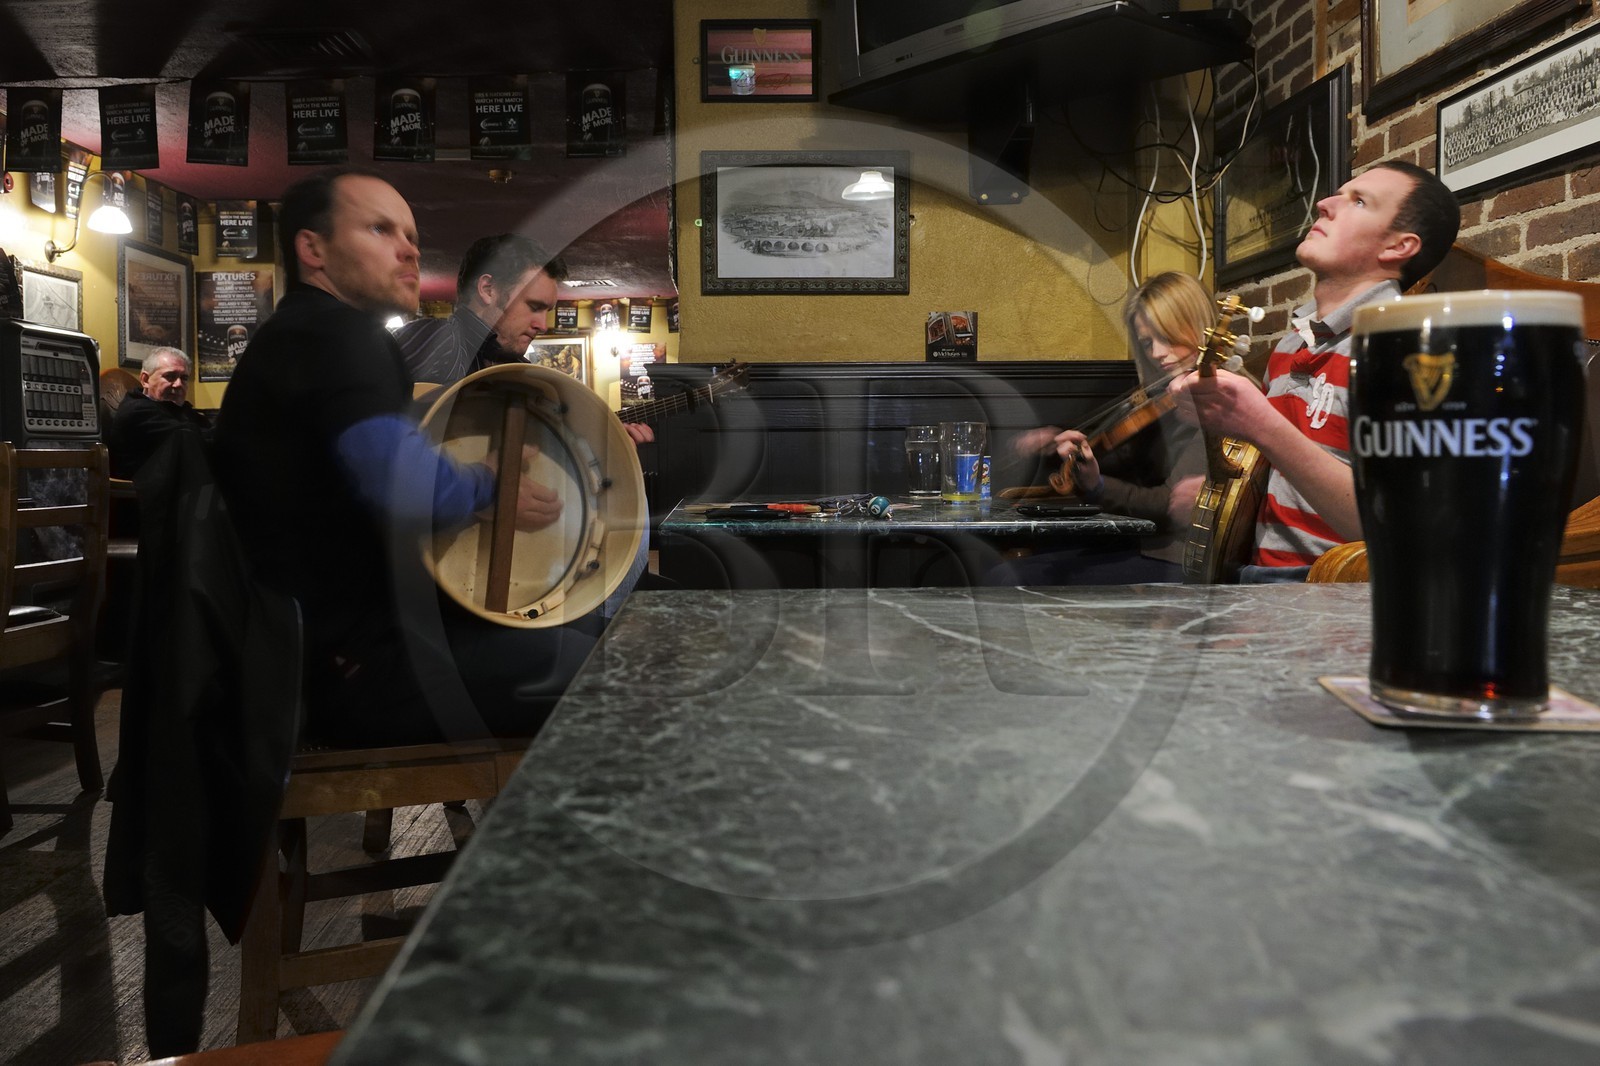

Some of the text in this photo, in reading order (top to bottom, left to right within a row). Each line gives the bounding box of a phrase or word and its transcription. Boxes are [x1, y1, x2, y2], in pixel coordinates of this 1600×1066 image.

[721, 45, 801, 64] GUINNESS
[293, 109, 340, 118] HERE LIVE
[475, 104, 523, 113] HERE LIVE
[107, 114, 150, 125] HERE LIVE
[390, 112, 421, 128] MADE
[582, 107, 612, 124] MADE
[204, 115, 235, 130] MADE
[582, 122, 591, 132] OF
[20, 123, 48, 139] MADE
[204, 129, 212, 138] OF
[390, 127, 399, 136] OF
[212, 272, 256, 281] FIXTURES
[1354, 415, 1534, 458] GUINNESS
